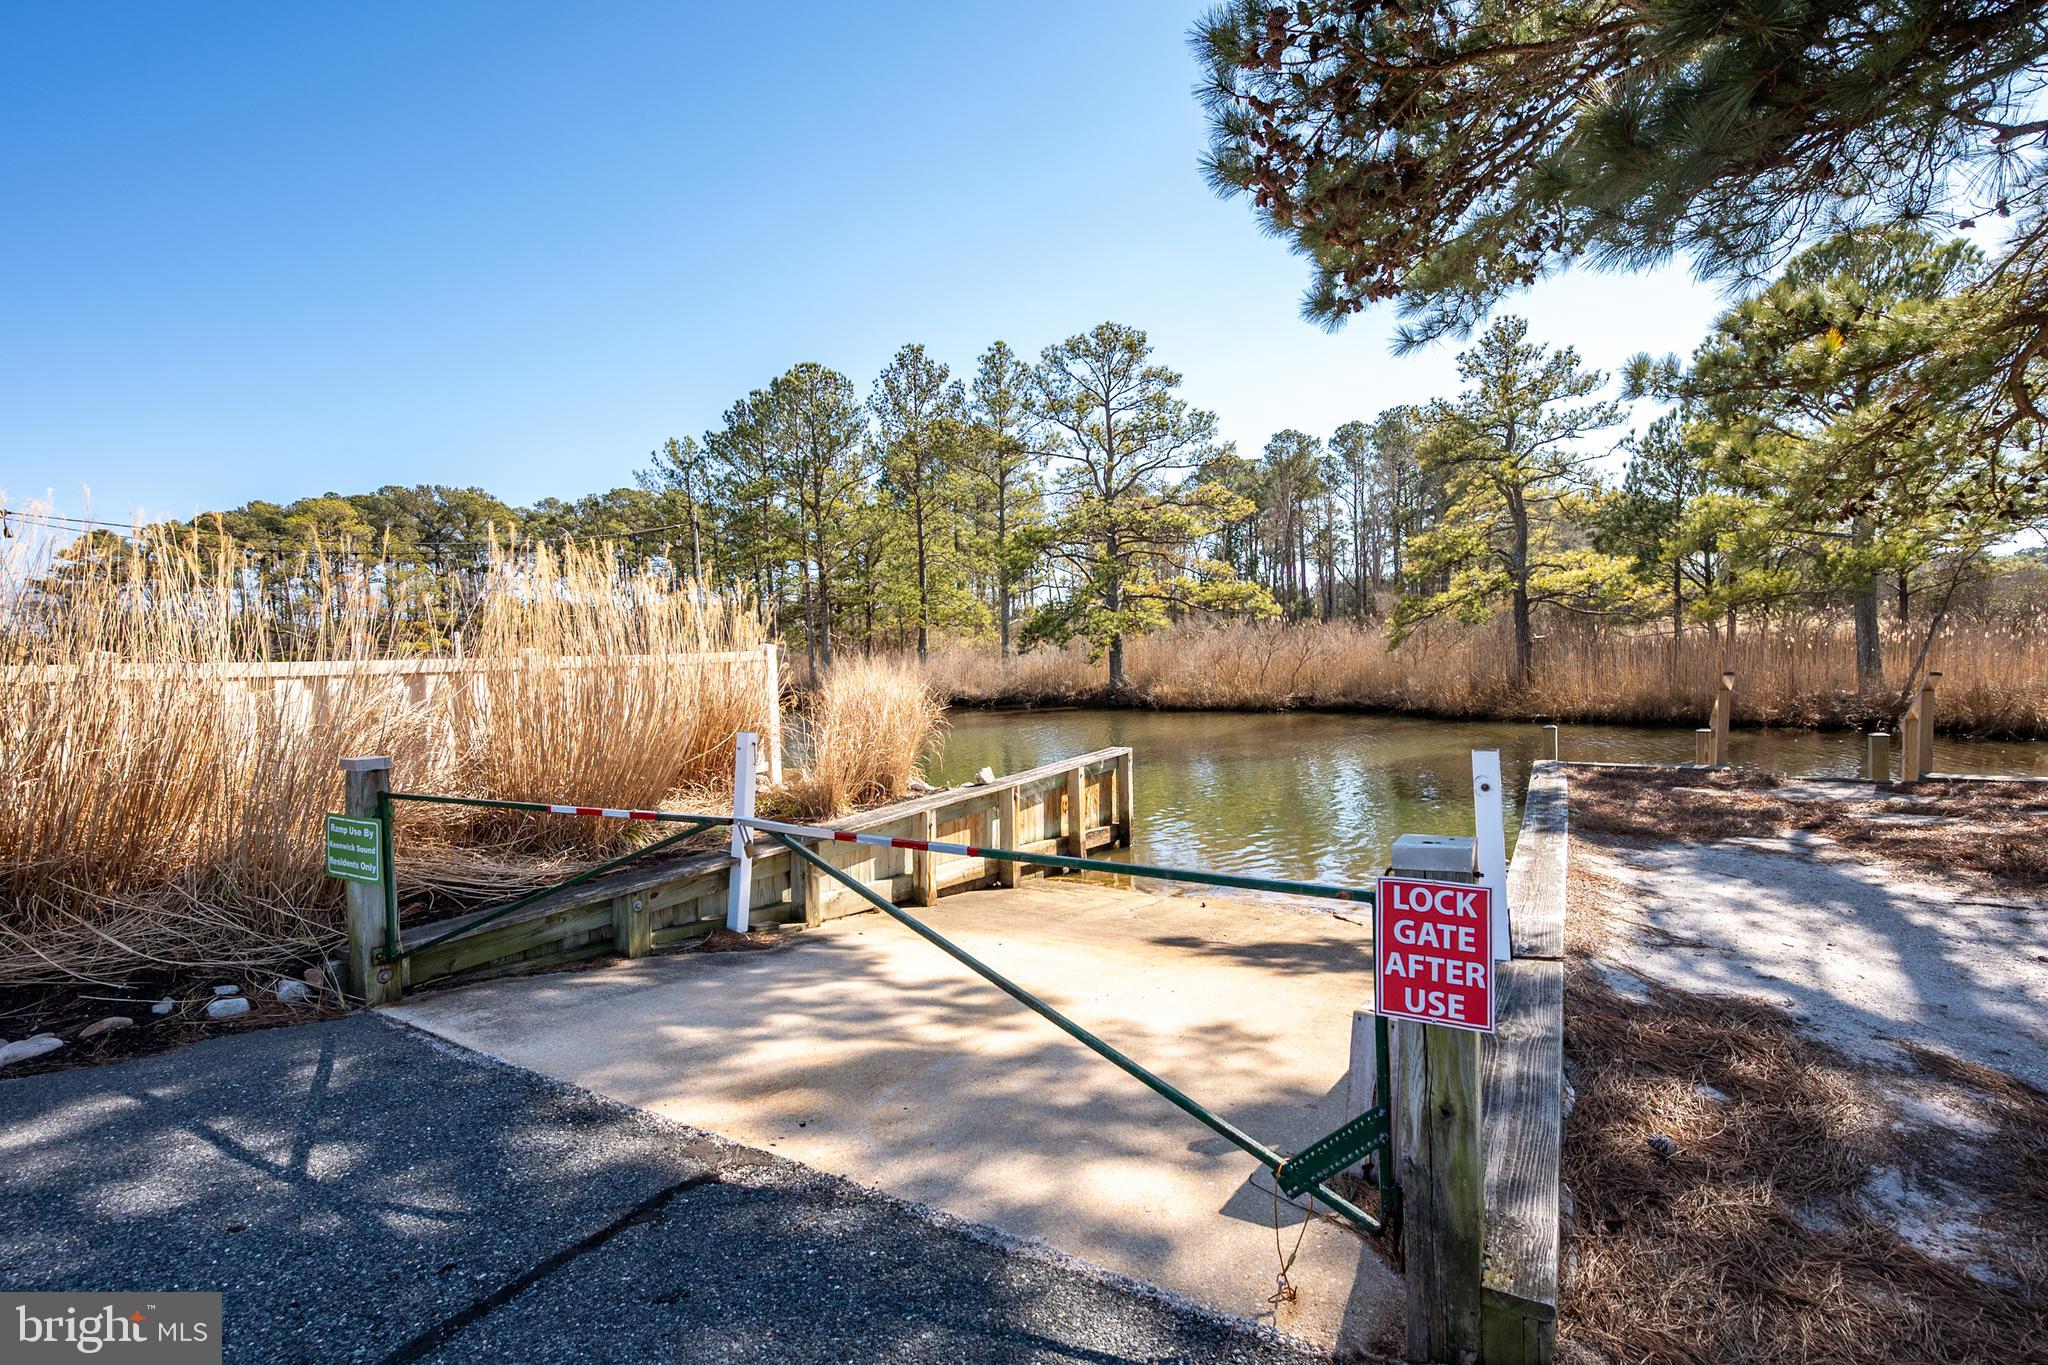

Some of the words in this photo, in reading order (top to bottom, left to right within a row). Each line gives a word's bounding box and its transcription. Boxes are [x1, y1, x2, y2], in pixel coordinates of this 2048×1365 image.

[330, 823, 348, 836] Ramp
[349, 826, 362, 836] Use
[363, 828, 374, 839] By
[329, 856, 359, 869] Residents
[360, 862, 376, 873] Only
[356, 845, 376, 854] Sound
[1393, 885, 1478, 918] LOCK
[1393, 919, 1476, 953] GATE
[1385, 951, 1486, 989] AFTER
[1404, 987, 1465, 1020] USE
